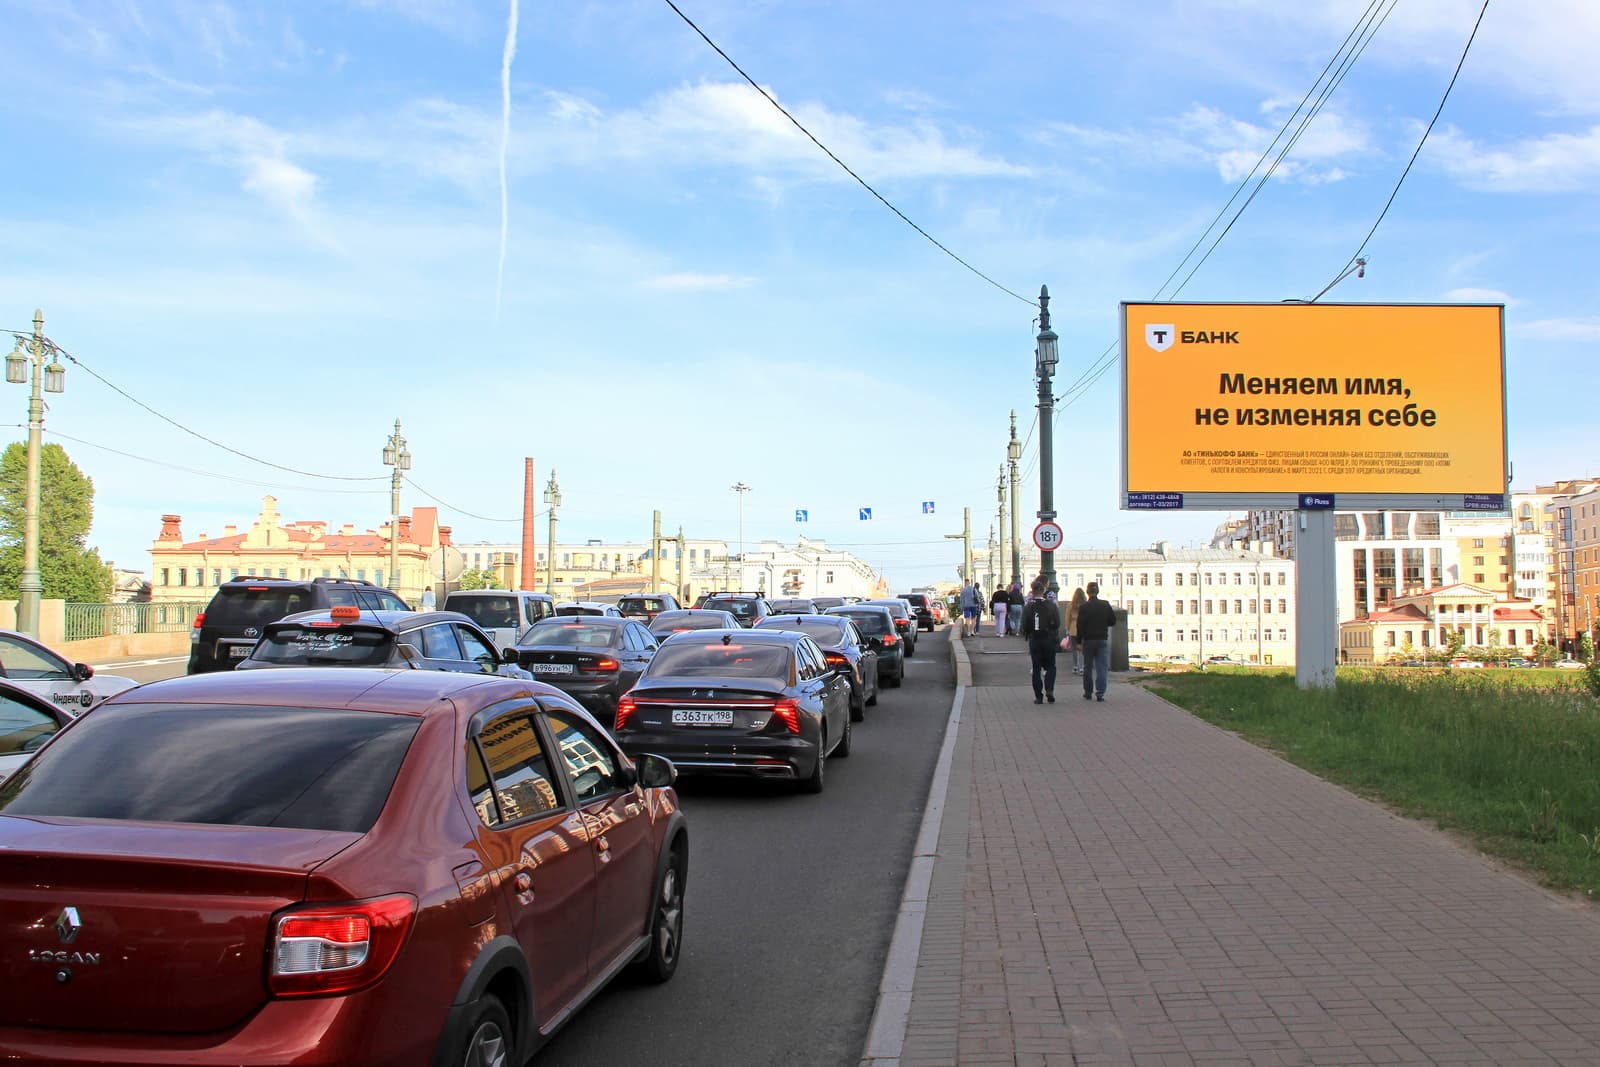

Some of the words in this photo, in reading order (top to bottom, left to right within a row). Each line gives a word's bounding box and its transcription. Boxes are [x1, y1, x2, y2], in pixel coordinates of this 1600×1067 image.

[1181, 331, 1240, 344] БАНК
[1219, 373, 1338, 395] Меняем
[1345, 378, 1412, 399] имя,
[1195, 408, 1229, 425] не
[1236, 407, 1361, 426] изменяя
[1368, 404, 1437, 427] себе
[1183, 450, 1192, 458] АО
[53, 692, 80, 705] Яндекс
[675, 711, 714, 721] С363ТК
[29, 949, 101, 965] LOGAN
